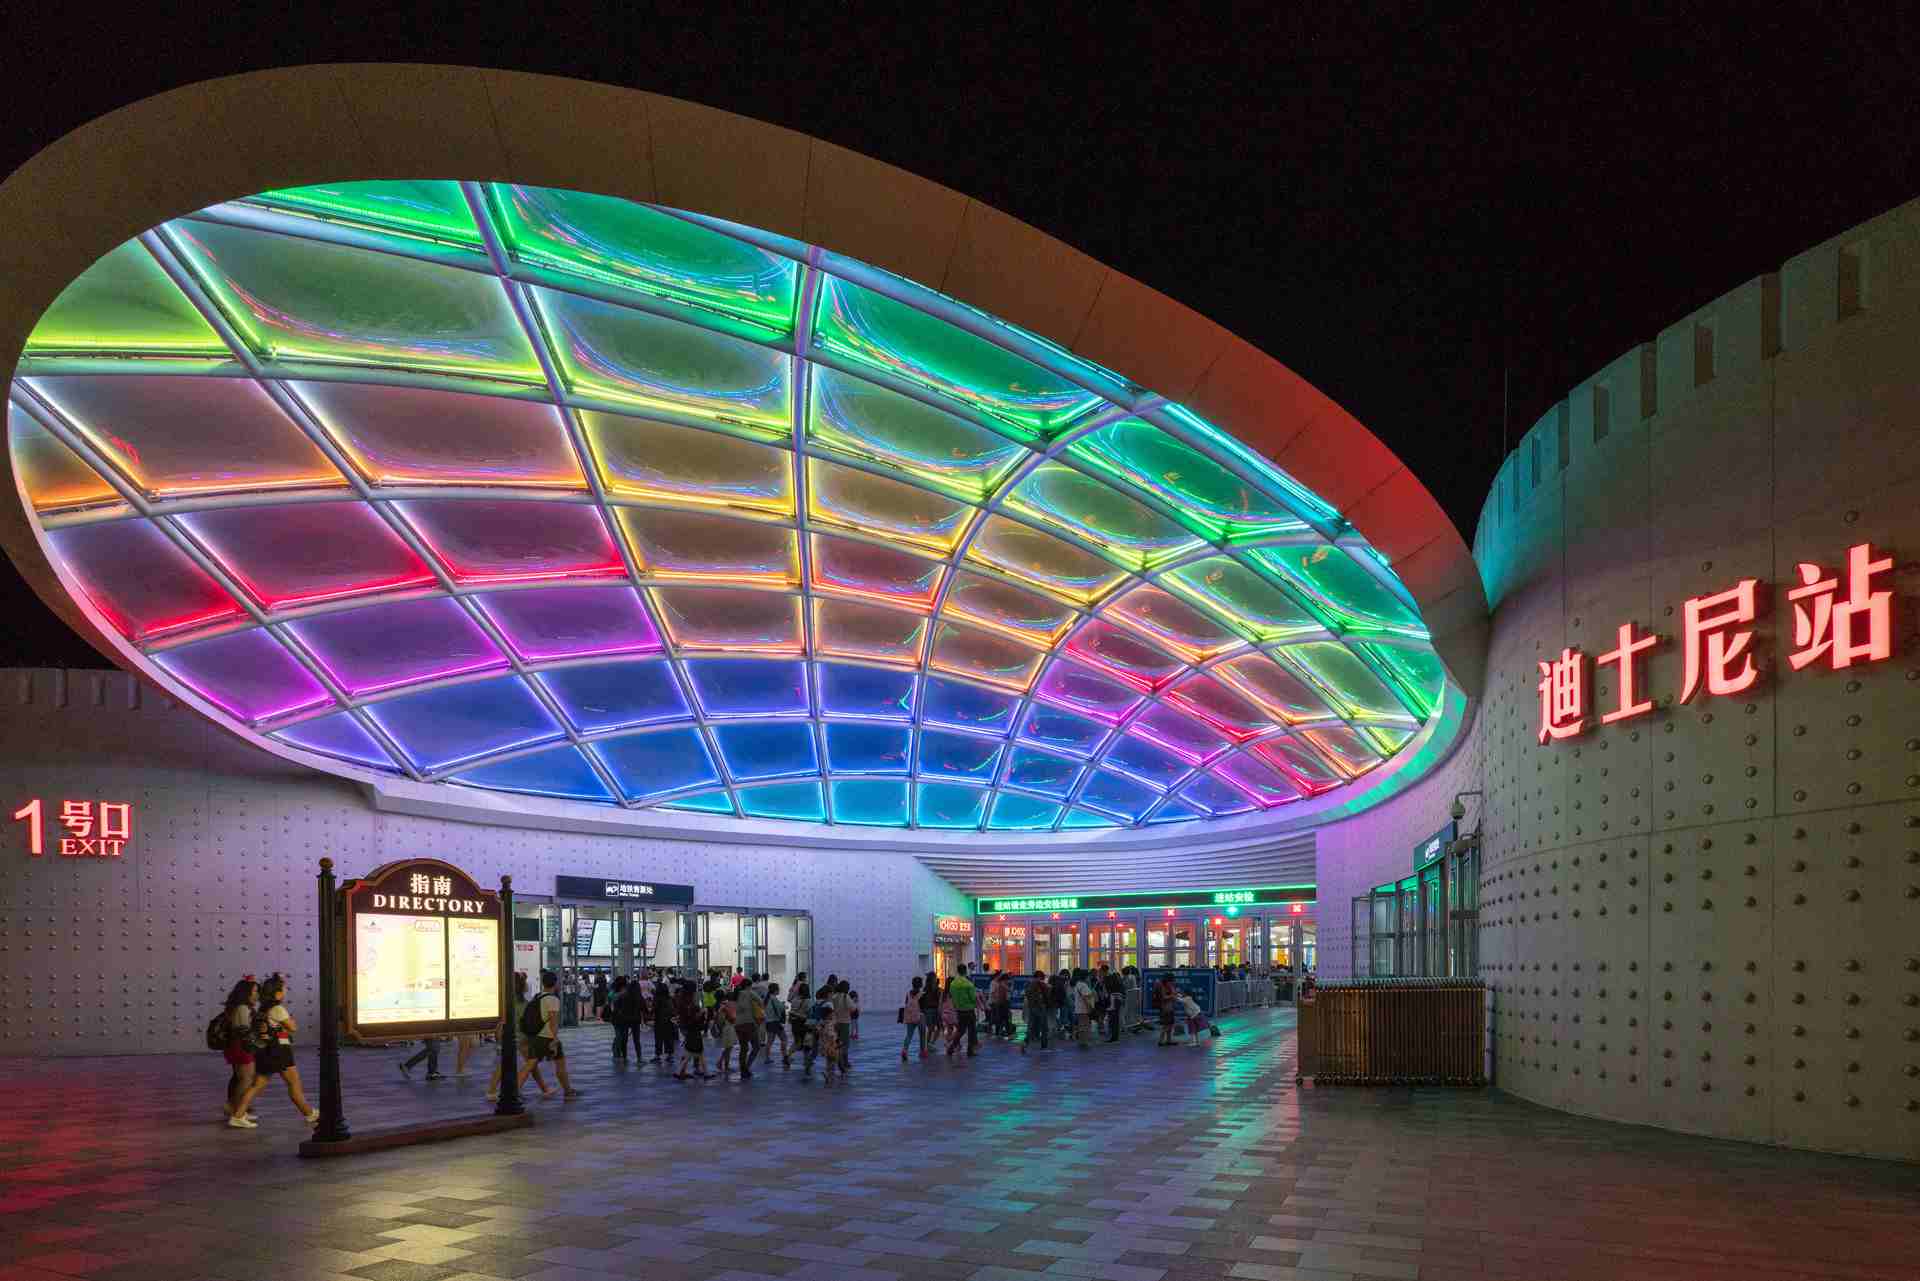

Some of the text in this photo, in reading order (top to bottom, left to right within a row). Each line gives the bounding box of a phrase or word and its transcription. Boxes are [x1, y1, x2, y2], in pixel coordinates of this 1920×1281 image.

[1537, 542, 1893, 744] 迪士尼站
[61, 838, 125, 856] EXIT
[410, 873, 452, 896] 指南
[373, 894, 485, 913] DIRECTORY
